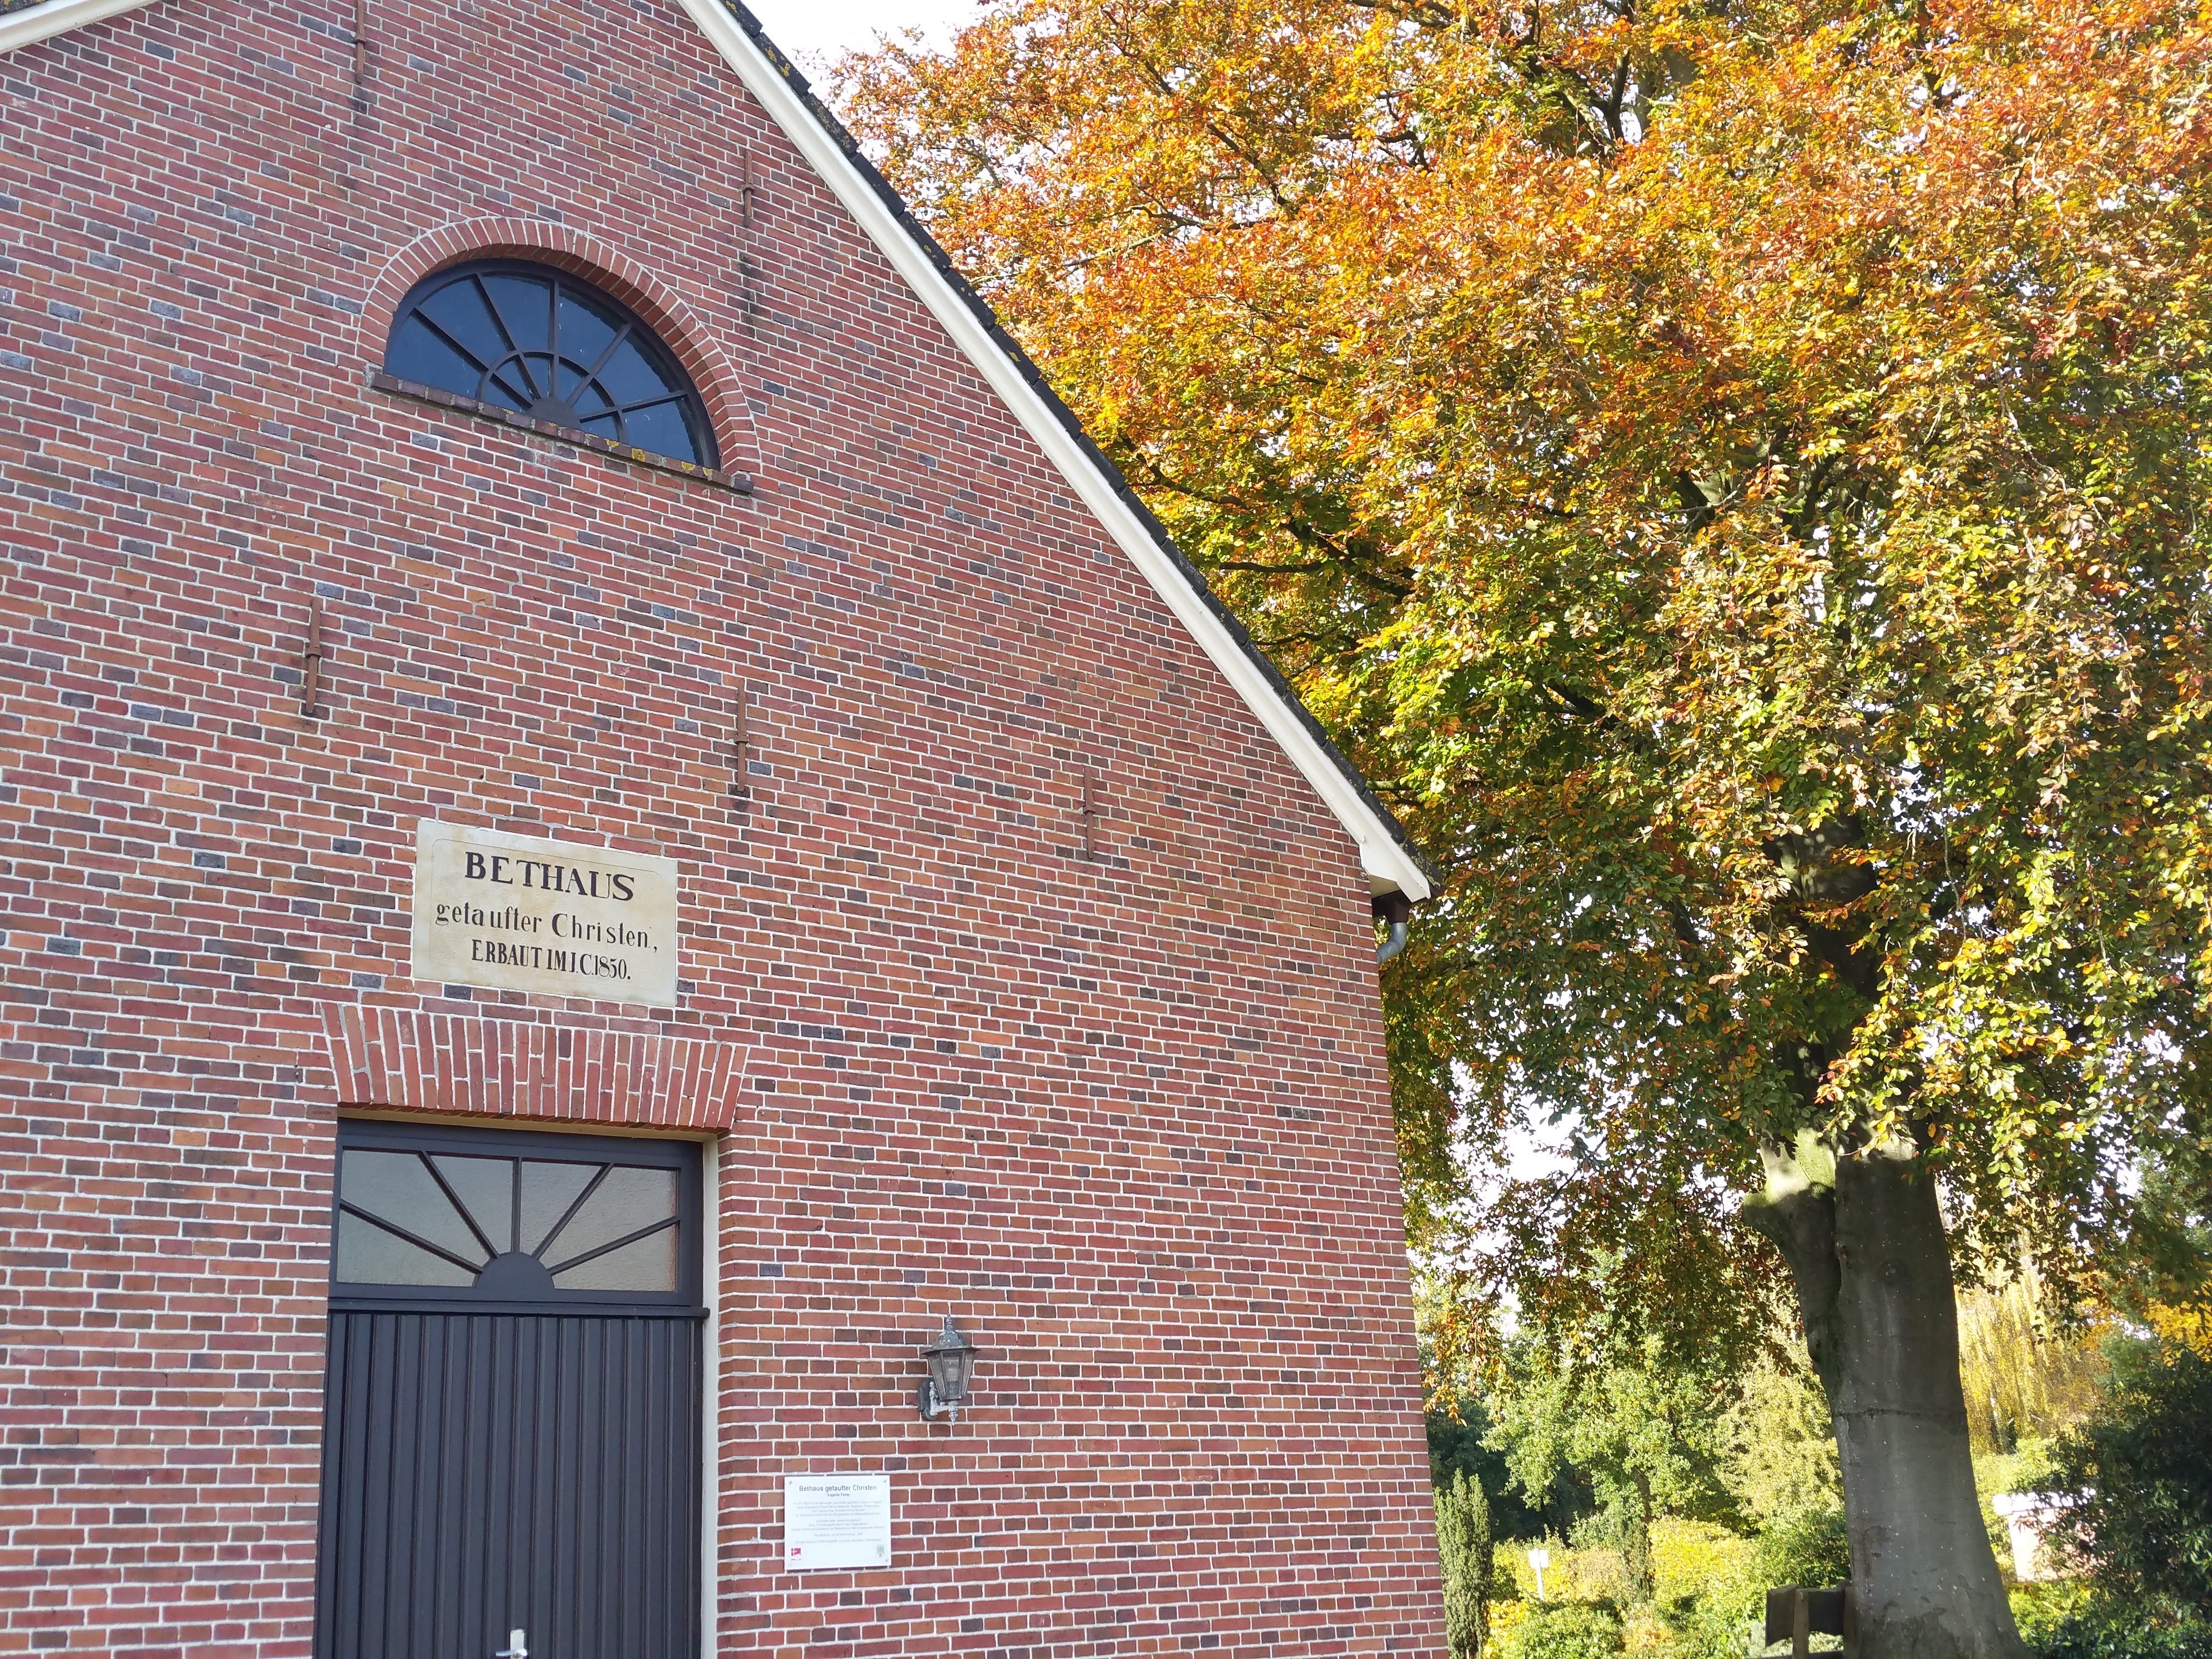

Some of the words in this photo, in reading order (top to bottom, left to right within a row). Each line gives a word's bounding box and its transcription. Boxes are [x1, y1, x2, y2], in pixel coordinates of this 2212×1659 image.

[465, 851, 635, 901] BETHAUS
[435, 902, 542, 933] getaufter
[471, 939, 542, 968] ERBAUT
